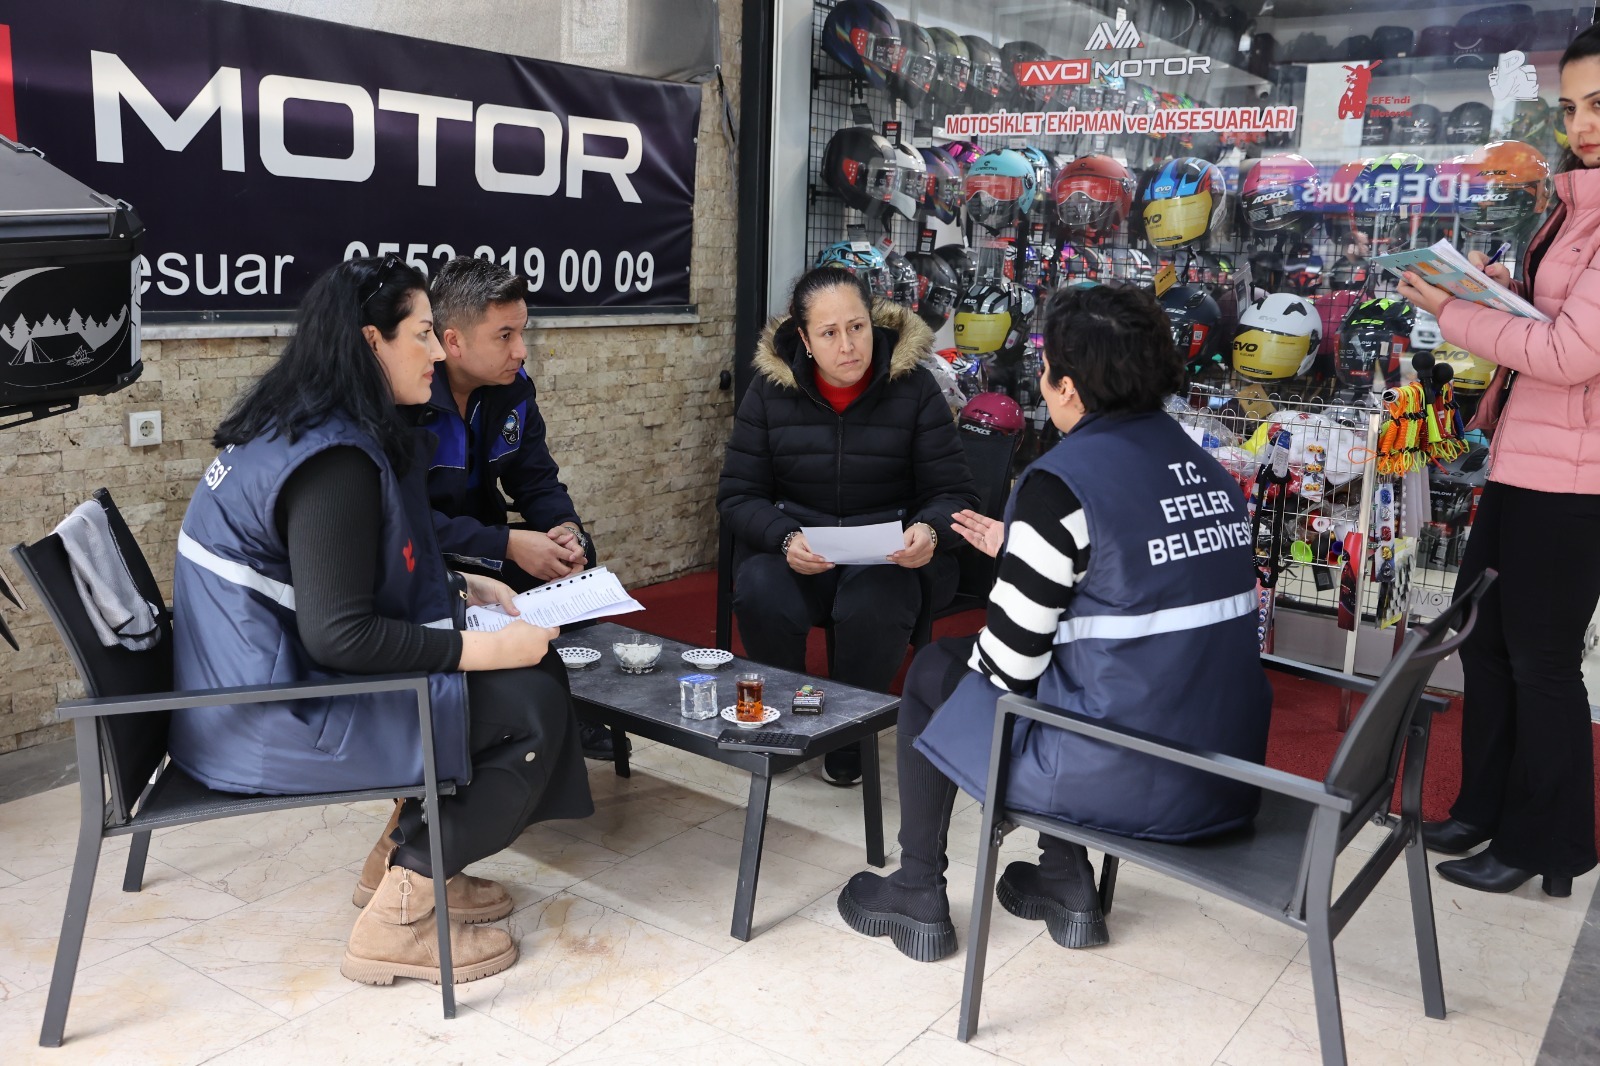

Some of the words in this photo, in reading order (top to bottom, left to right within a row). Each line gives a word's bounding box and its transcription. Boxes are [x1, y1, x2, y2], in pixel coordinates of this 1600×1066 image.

[1022, 61, 1088, 81] AVCI
[1094, 56, 1211, 78] MOTOR
[90, 49, 643, 204] MOTOR
[946, 111, 1043, 135] MOTOSİKLET
[1047, 109, 1122, 133] EKİPMAN
[1126, 115, 1149, 131] ve
[1153, 108, 1294, 131] AKSESUARLARI
[559, 248, 602, 293] 00
[614, 250, 655, 293] 09
[1233, 340, 1259, 353] EVO
[1434, 350, 1470, 361] EVO
[1168, 461, 1207, 486] T.C.
[1160, 490, 1234, 523] EFELER
